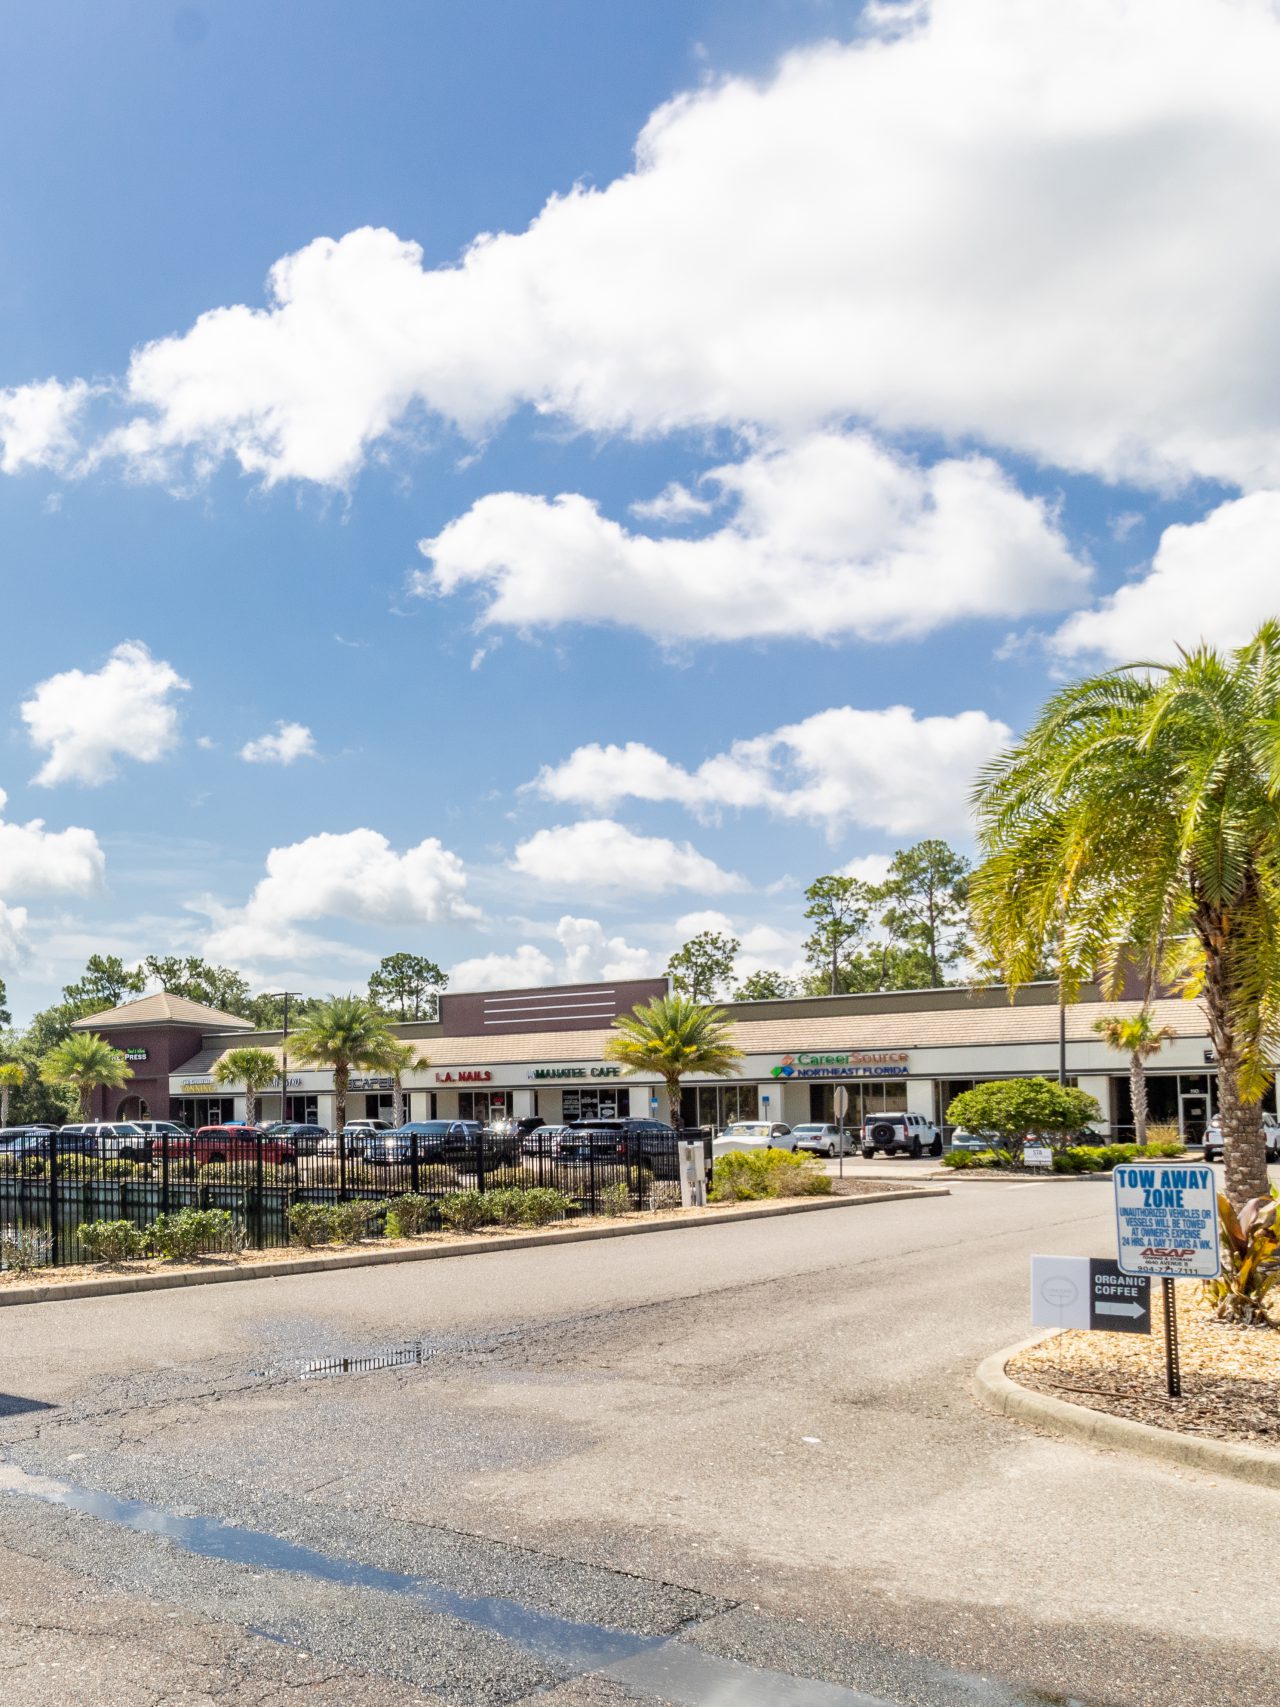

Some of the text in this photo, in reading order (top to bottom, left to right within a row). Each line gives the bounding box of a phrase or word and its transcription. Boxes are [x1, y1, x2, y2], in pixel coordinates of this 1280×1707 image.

[797, 1052, 909, 1066] CareerSource
[458, 1070, 492, 1082] NAILS
[535, 1066, 621, 1079] MANATEE CAFE
[797, 1066, 909, 1077] NORTHEAST FLORIDA
[1116, 1169, 1209, 1189] TOW AWAY
[1143, 1189, 1185, 1208] ZONE
[1119, 1207, 1212, 1219] UNAUTHORIZED VEHICLES OR
[1125, 1217, 1206, 1230] VESSELS WILL BE TOWED
[1131, 1227, 1139, 1236] AT
[1171, 1228, 1201, 1239] EXPENSE
[1122, 1237, 1130, 1247] 24
[1147, 1238, 1152, 1247] A
[1153, 1238, 1166, 1248] DAY
[1173, 1239, 1191, 1249] DAYS
[1192, 1239, 1198, 1249] A
[1140, 1247, 1196, 1257] ASAP
[1094, 1274, 1147, 1287] ORGANIC
[1094, 1285, 1139, 1297] COFFEE
